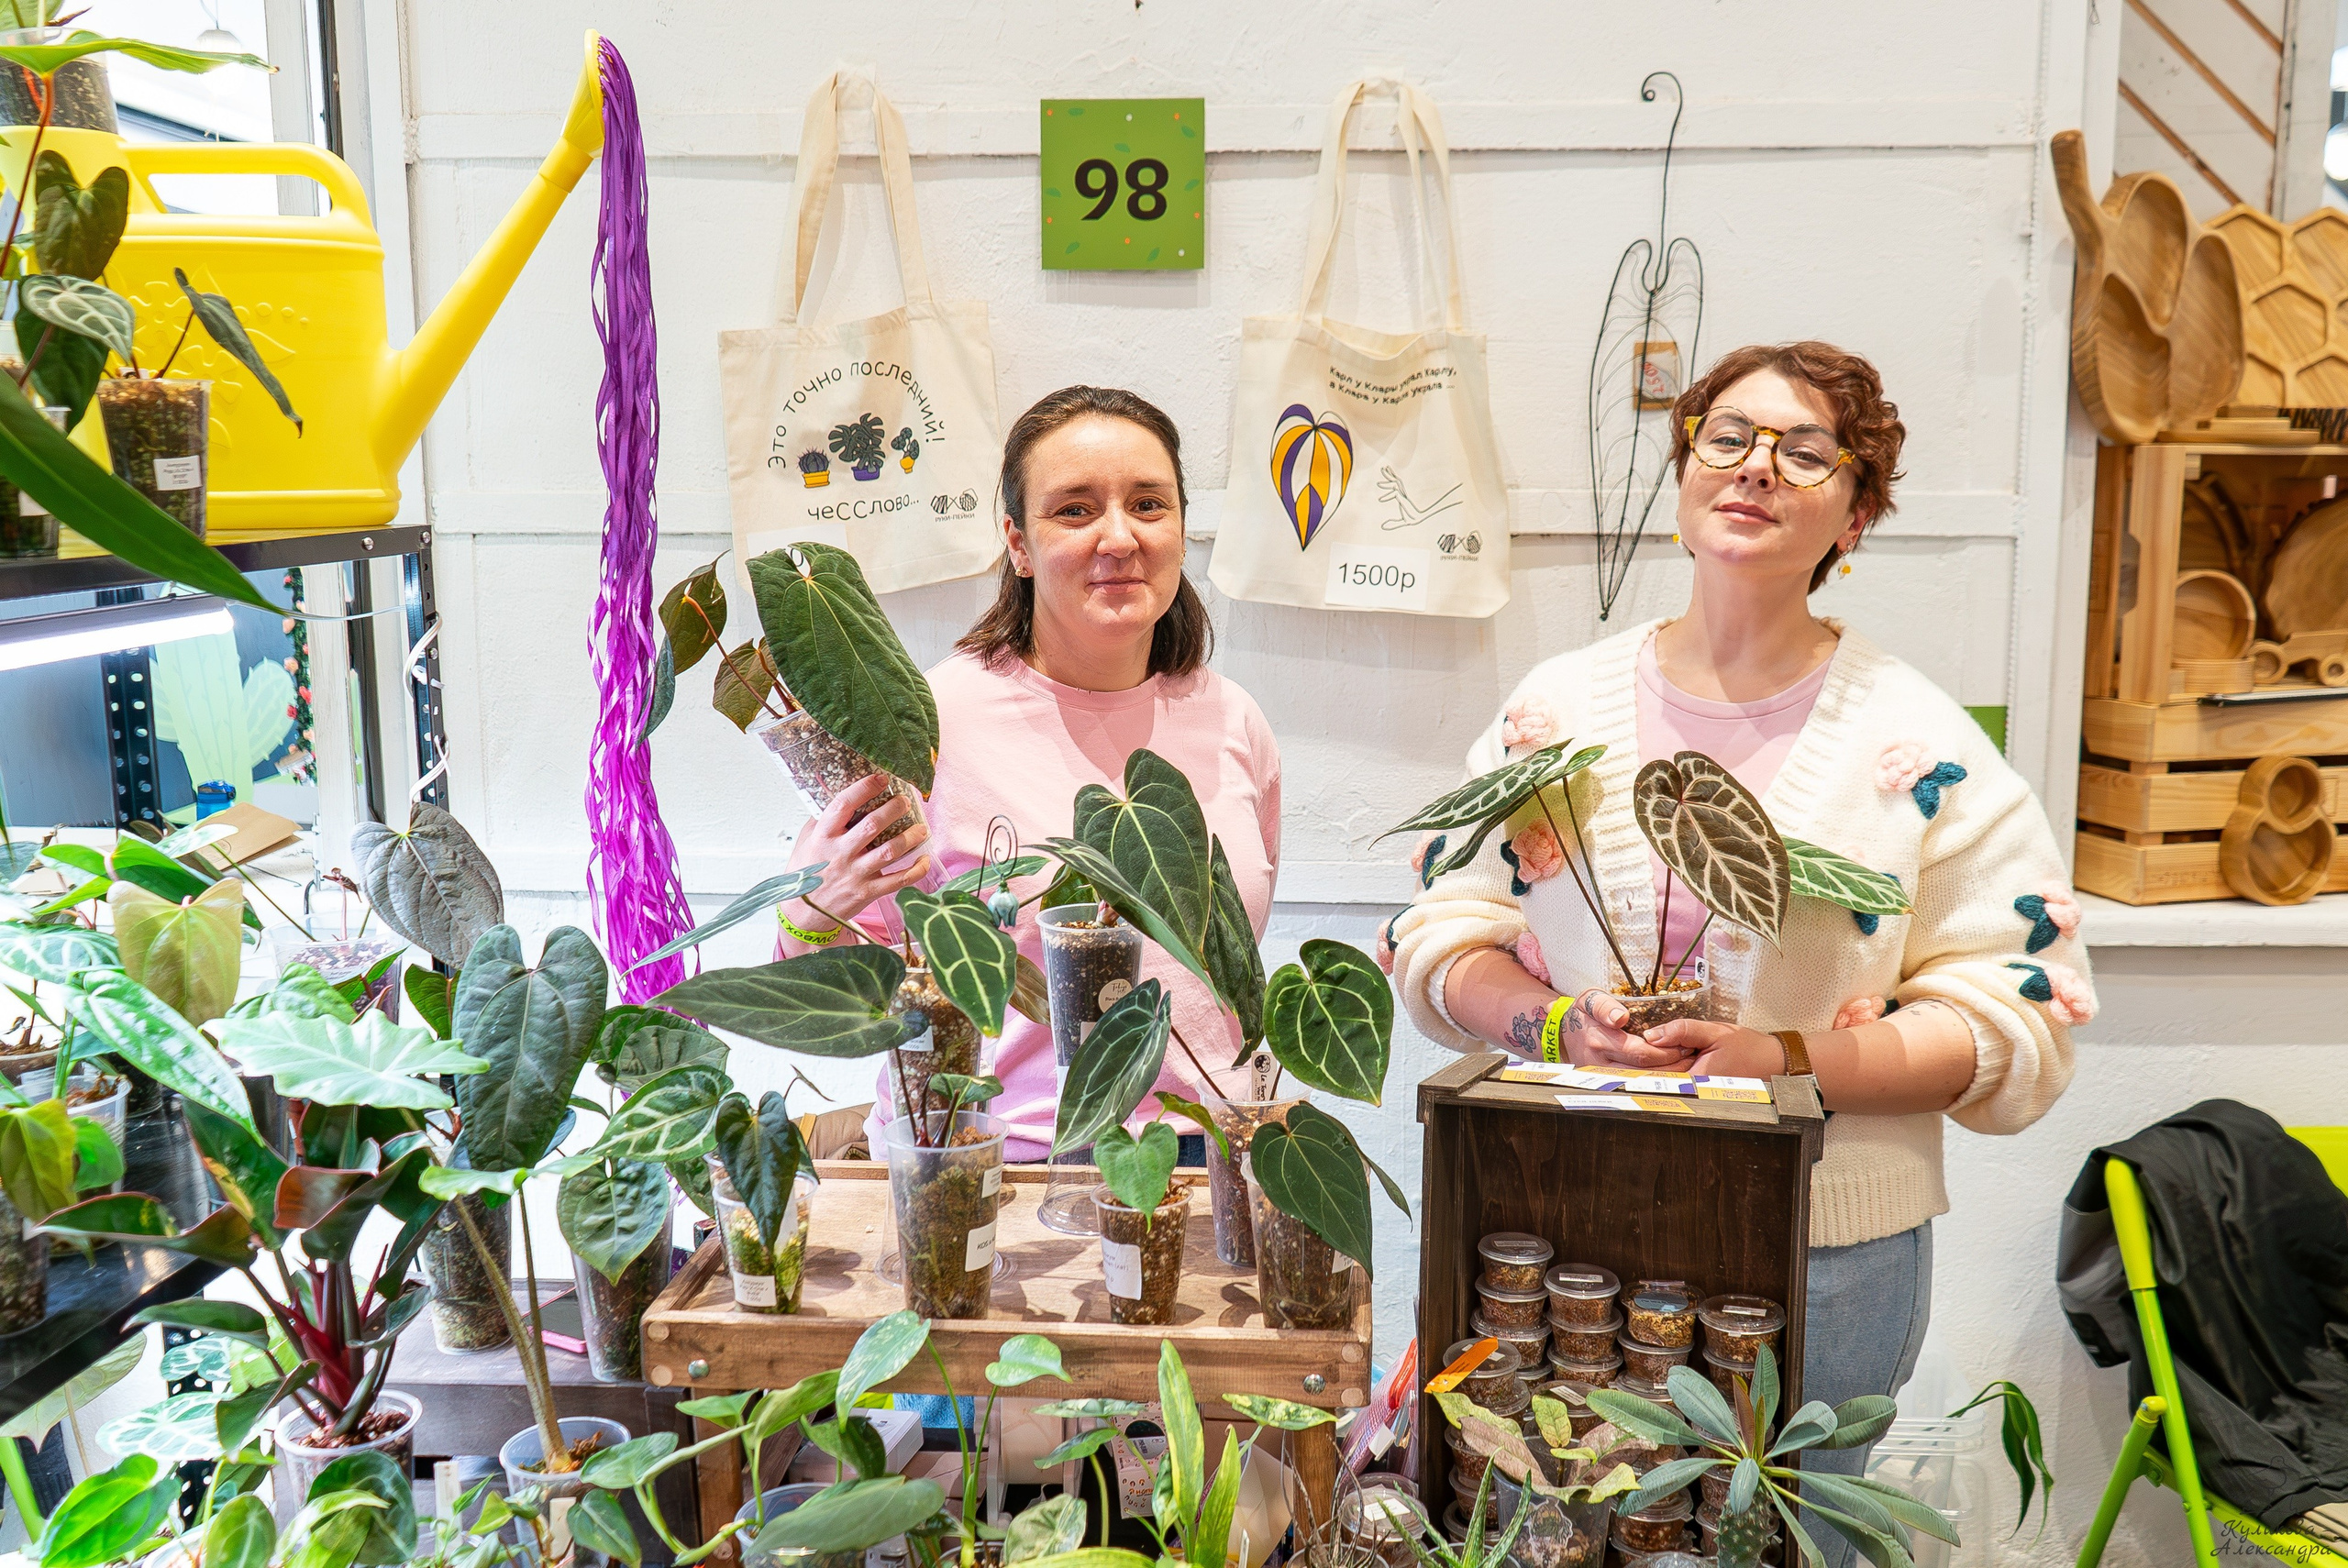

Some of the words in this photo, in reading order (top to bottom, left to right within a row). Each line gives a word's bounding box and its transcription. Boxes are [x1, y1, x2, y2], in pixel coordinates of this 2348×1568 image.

[1074, 158, 1169, 221] 98
[768, 425, 787, 469] Это
[782, 368, 842, 413] точно
[850, 361, 945, 442] последний!
[786, 924, 841, 944] OWBOX
